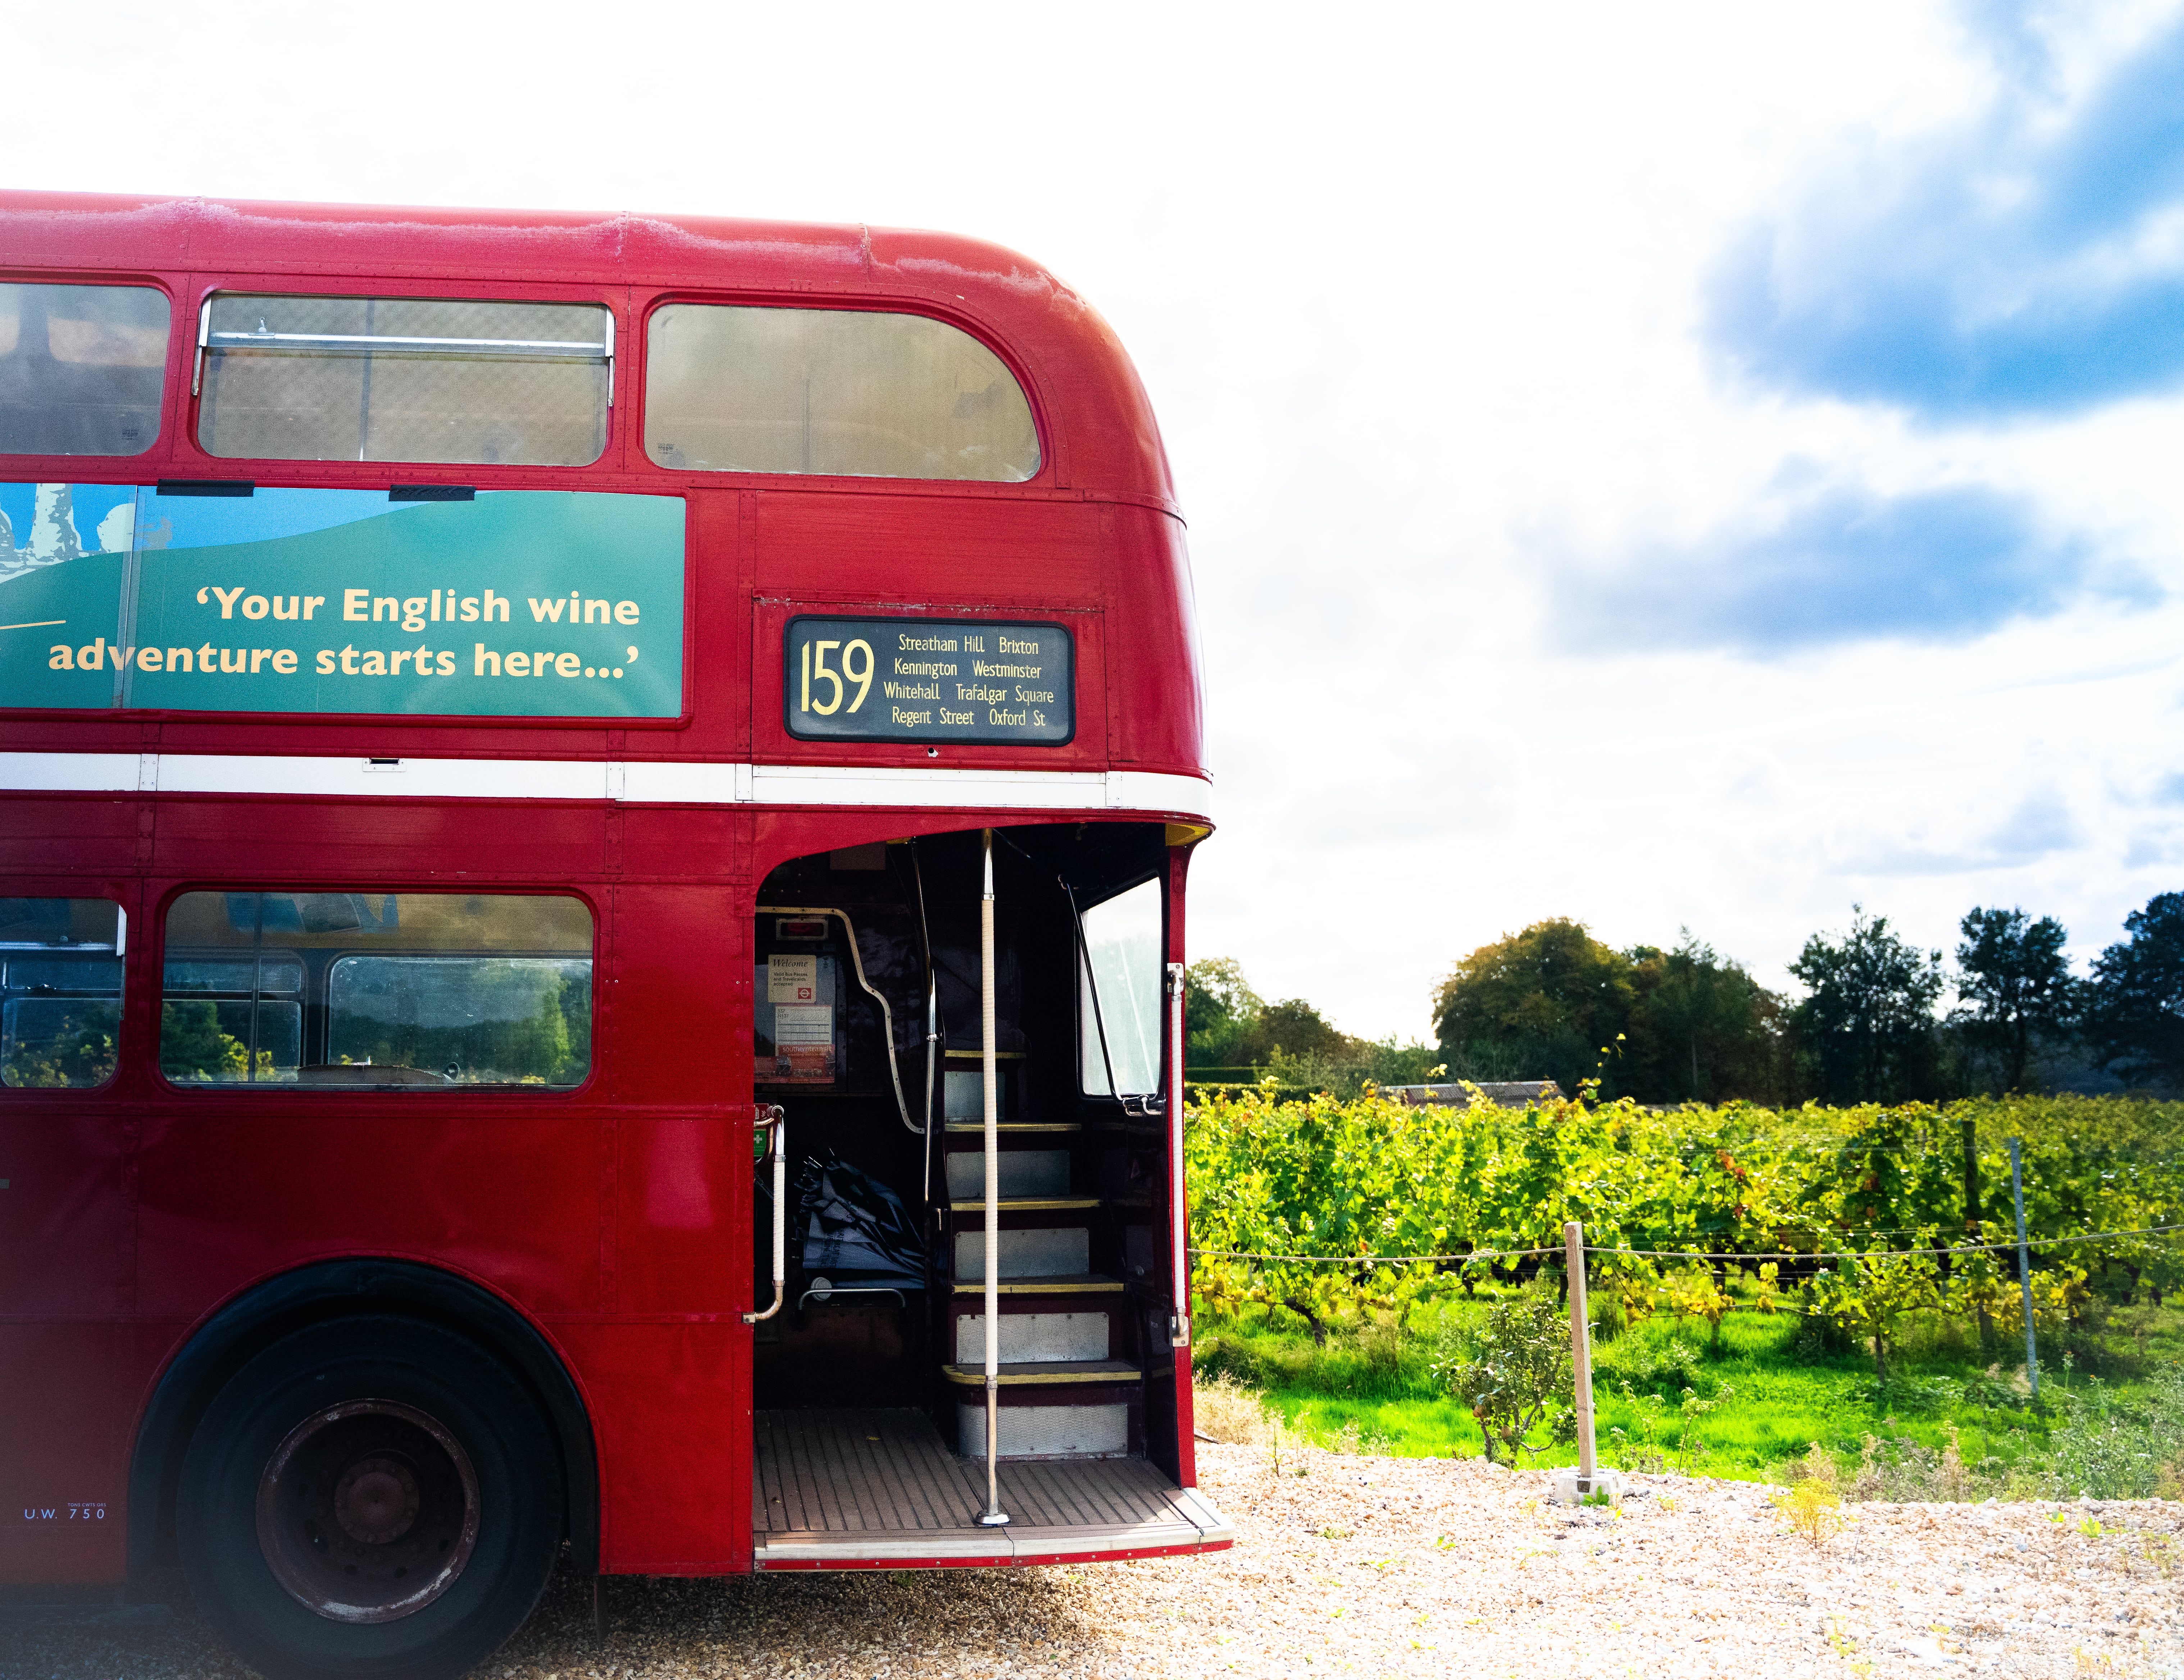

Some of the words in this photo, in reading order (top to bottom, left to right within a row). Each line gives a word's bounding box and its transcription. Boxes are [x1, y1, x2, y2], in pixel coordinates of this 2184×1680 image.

[344, 589, 510, 632] English
[528, 590, 640, 625] wine
[898, 634, 957, 652] Streatham
[964, 636, 985, 653] Hill
[999, 636, 1039, 655] Brixton
[49, 638, 297, 674] adventure
[316, 644, 456, 676] starts
[801, 639, 875, 716] 159
[895, 658, 957, 680] Kennington
[972, 659, 1042, 679] Westminster
[883, 681, 941, 700] Whitehall
[956, 683, 1007, 706] Trafalgar
[1015, 686, 1054, 706] Square
[892, 706, 932, 728] Regent
[939, 707, 974, 725] Street
[989, 709, 1026, 726] Oxford
[1033, 710, 1046, 727] St
[773, 959, 808, 967] Welcome
[24, 1509, 58, 1519] U.W.
